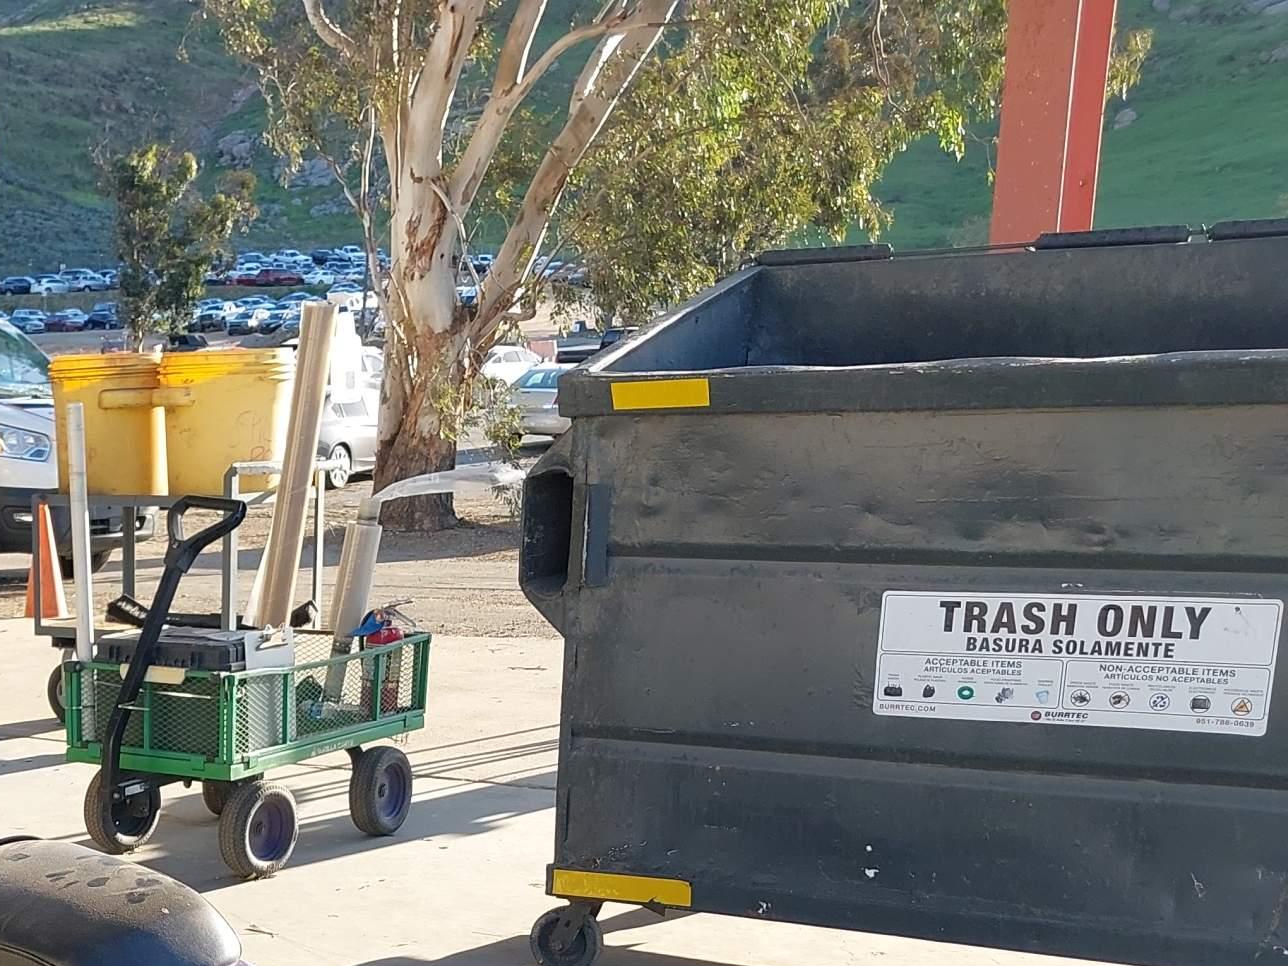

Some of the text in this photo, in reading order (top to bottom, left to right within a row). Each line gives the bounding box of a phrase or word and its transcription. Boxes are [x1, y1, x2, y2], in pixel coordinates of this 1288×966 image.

[939, 600, 1212, 640] TRASH ONLY
[965, 637, 1175, 659] BASURA SOLAMENTE
[925, 657, 1023, 669] ACCEPTABLE ITEMS
[970, 668, 1023, 676] ACEPTABLES
[1099, 664, 1237, 678] NON-ACCEPTABLE ITEMS
[1171, 676, 1229, 685] ACEPTABLES
[879, 703, 936, 712] BURRTEC.COM
[1044, 711, 1089, 719] BURRTEC
